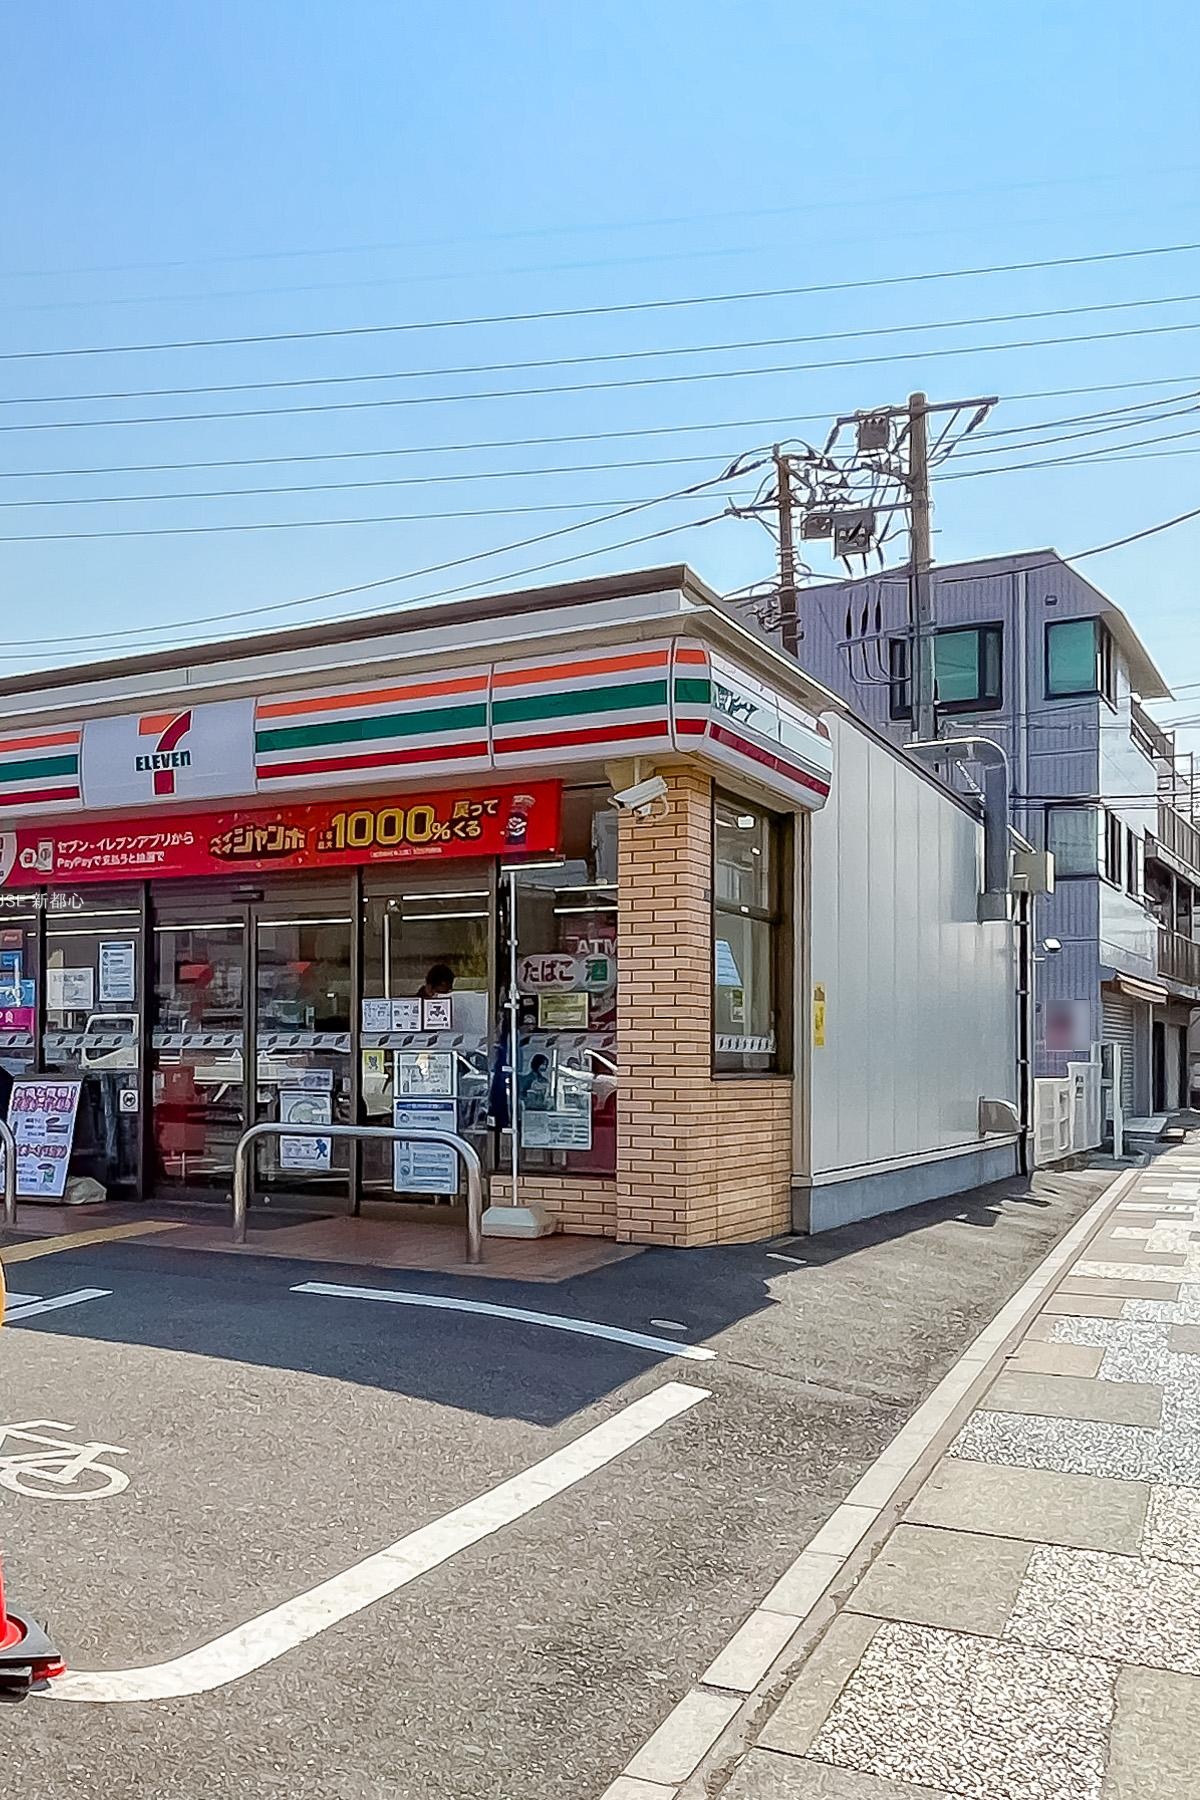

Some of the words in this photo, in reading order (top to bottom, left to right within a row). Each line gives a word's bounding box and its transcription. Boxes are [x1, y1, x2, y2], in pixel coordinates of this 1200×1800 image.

[138, 709, 193, 796] 7
[453, 799, 498, 819] 戻って
[331, 805, 451, 849] 1000%
[453, 820, 481, 837] くる
[523, 960, 575, 983] たばこ
